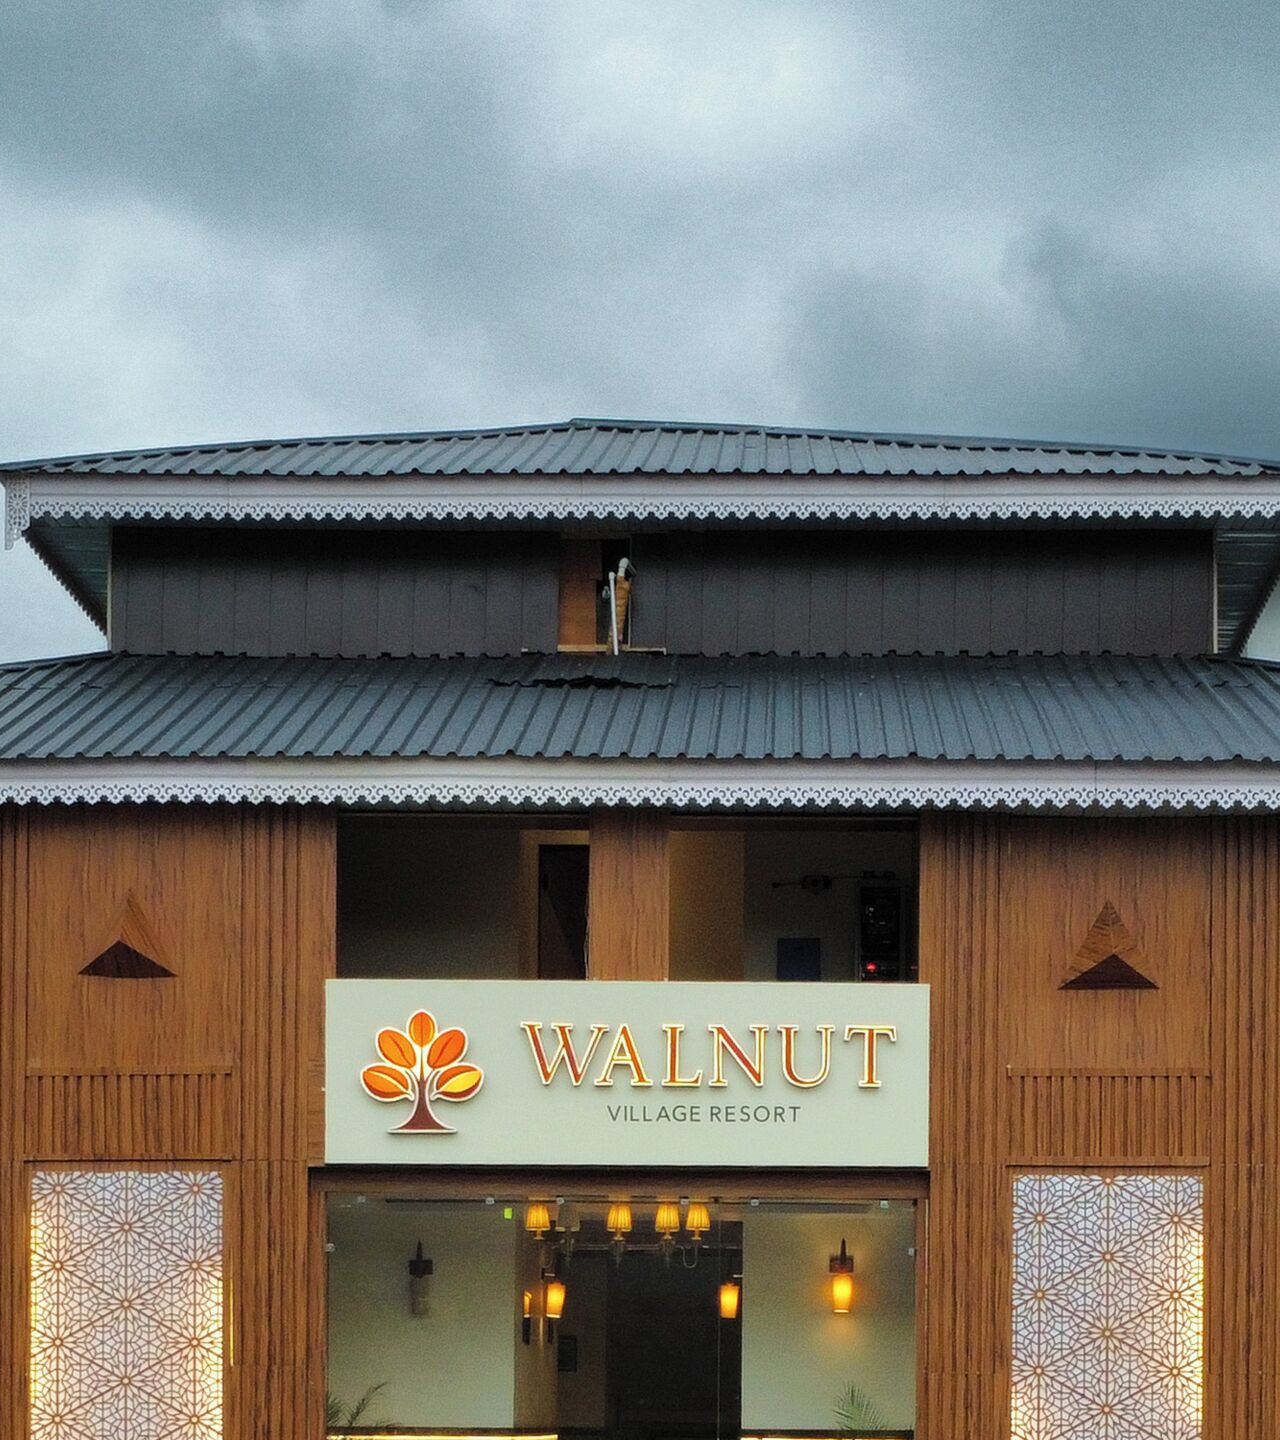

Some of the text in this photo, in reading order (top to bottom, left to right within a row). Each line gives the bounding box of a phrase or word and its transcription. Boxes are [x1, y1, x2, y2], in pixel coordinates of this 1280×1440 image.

[521, 1021, 897, 1088] WALNUT
[607, 1105, 802, 1123] VILLAGE RESORT
